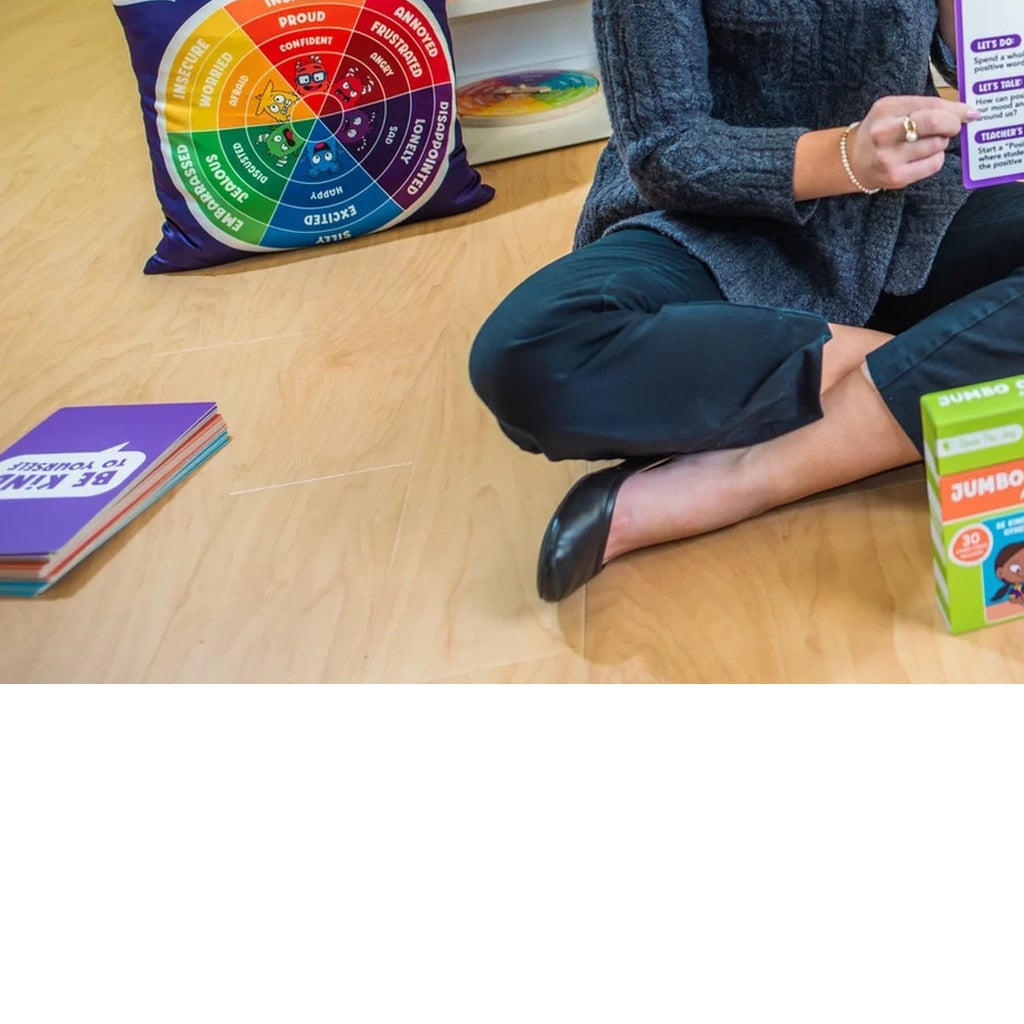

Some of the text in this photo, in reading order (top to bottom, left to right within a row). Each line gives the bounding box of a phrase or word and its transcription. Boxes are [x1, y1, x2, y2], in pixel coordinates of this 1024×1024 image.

[278, 10, 327, 28] PROUD
[393, 6, 439, 58] ANNOYED
[279, 36, 334, 52] CONFIDENT
[370, 20, 423, 78] FRUSTRATED
[977, 38, 997, 50] LET'S
[172, 37, 211, 100] INSECURE
[370, 52, 395, 77] ANGRY
[974, 54, 998, 65] Spend
[974, 63, 1004, 73] positive
[199, 51, 233, 108] WORRIED
[979, 81, 998, 92] LET'S
[228, 74, 249, 107] AFRAID
[976, 97, 993, 105] How
[995, 95, 1008, 103] can
[991, 102, 1013, 112] mood
[1005, 109, 1018, 118] us?
[385, 126, 398, 145] SAD
[400, 118, 426, 165] LONELY
[981, 127, 1023, 141] TEACHER'S
[407, 101, 449, 195] DISAPPOINTED
[978, 146, 997, 154] Start
[232, 142, 269, 184] DISGUSTED
[978, 153, 1001, 162] where
[978, 163, 991, 171] the
[993, 158, 1024, 169] positive
[205, 153, 250, 204] JEALOUS
[176, 144, 245, 232] EMBARRASSED
[310, 186, 344, 200] HAPPY
[304, 204, 357, 226] EXCITED
[315, 230, 352, 244] SILLY
[937, 383, 1010, 408] JUMBO
[7, 458, 127, 472] TO YOURSELF
[72, 470, 118, 488] BE
[951, 469, 1024, 502] JUMBO
[962, 532, 980, 548] 30
